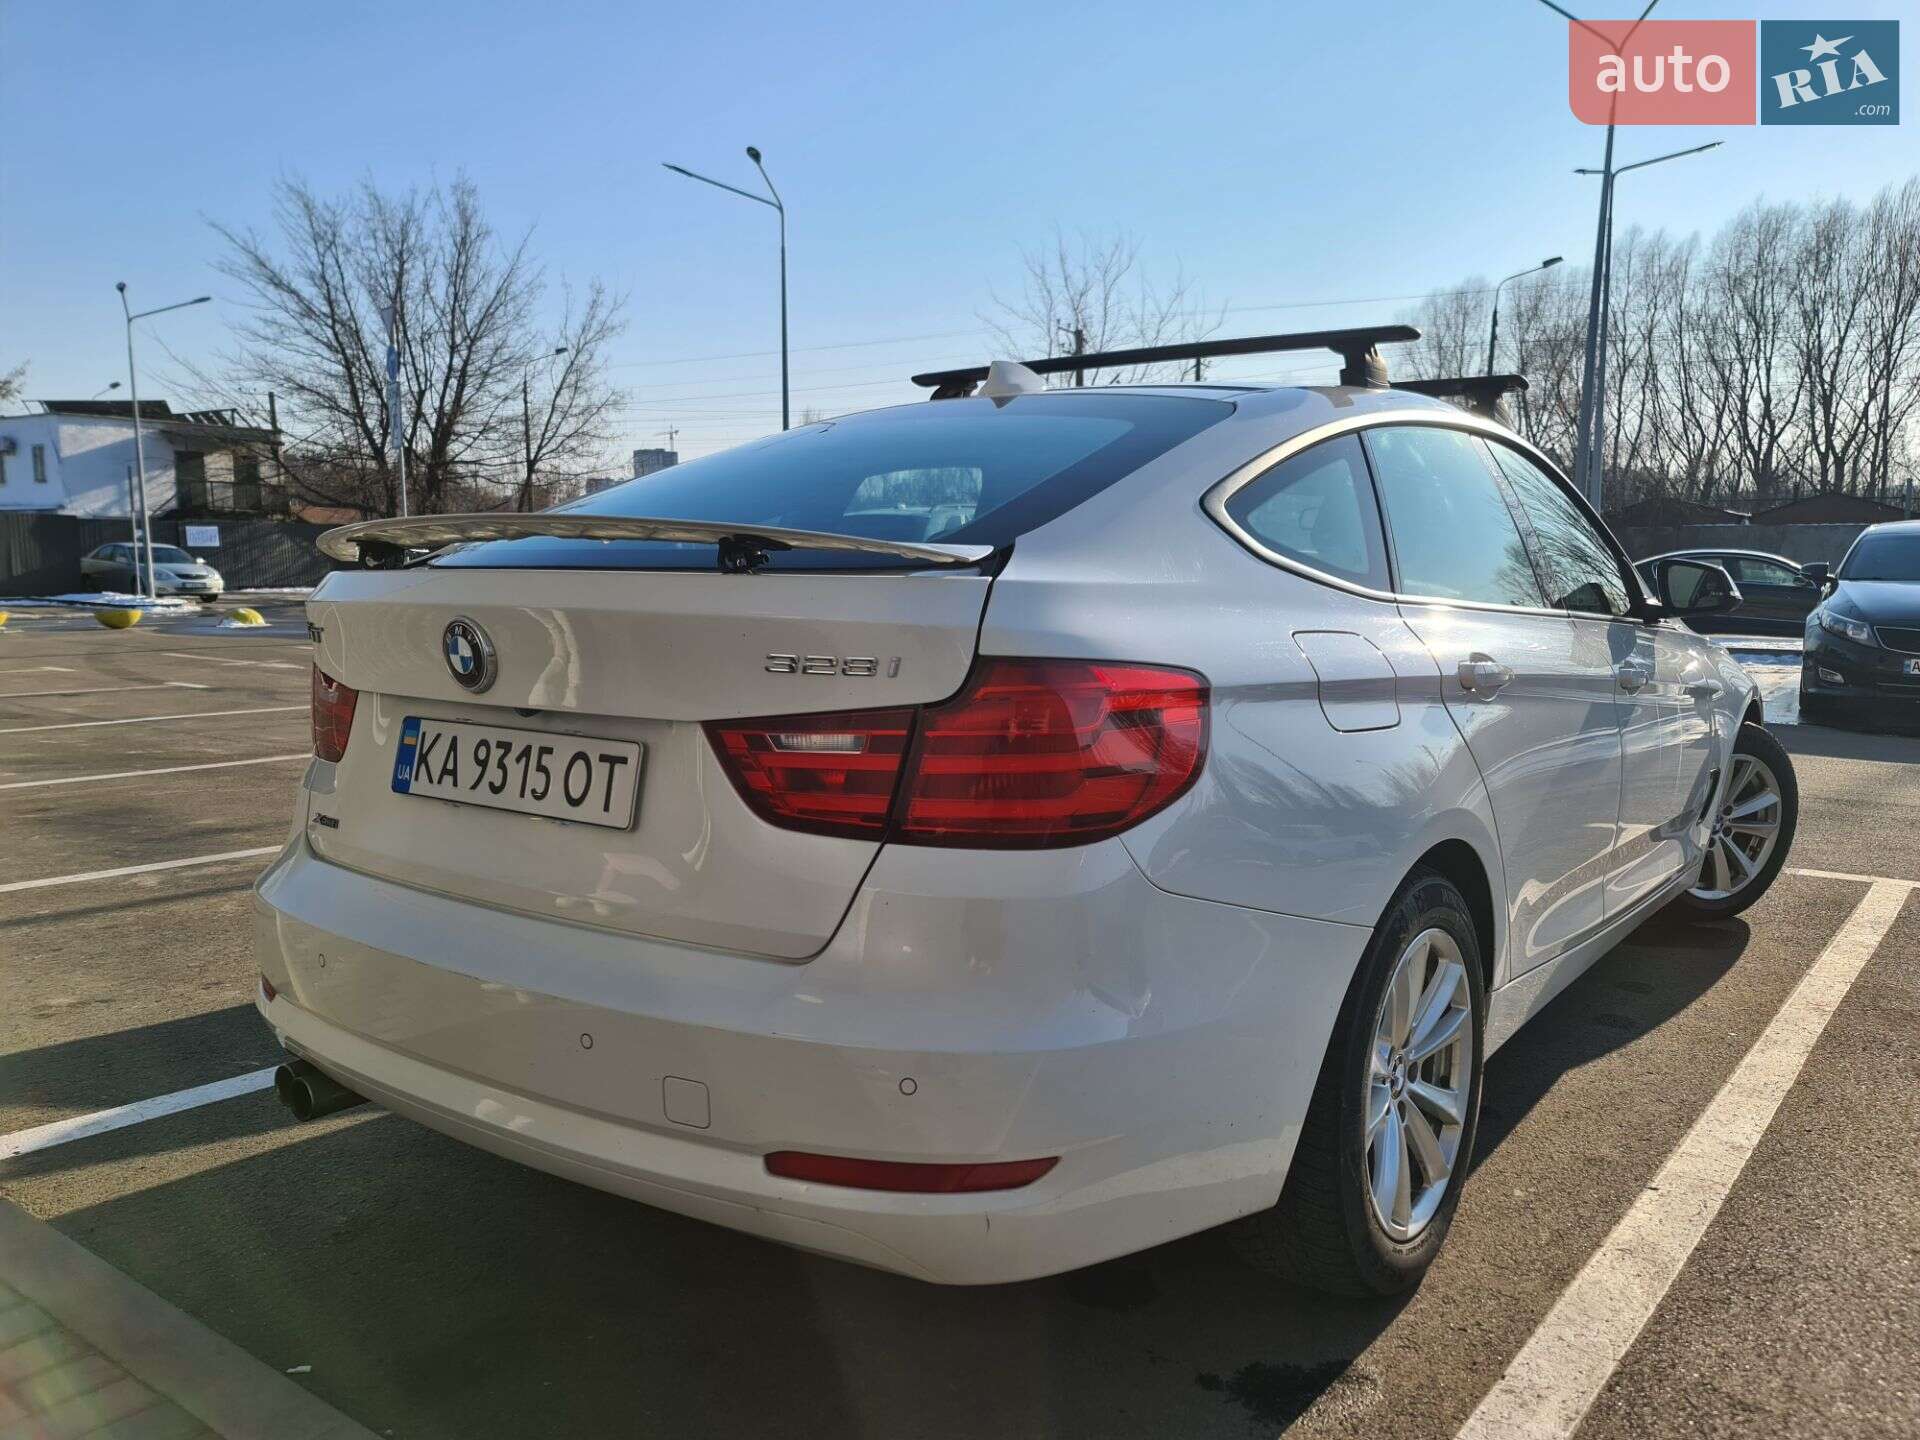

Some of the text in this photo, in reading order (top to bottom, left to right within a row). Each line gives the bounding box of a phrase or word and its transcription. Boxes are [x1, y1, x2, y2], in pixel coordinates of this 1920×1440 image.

[765, 653, 902, 678] 328i
[397, 764, 410, 780] UA
[414, 731, 628, 813] KA 9315 OT
